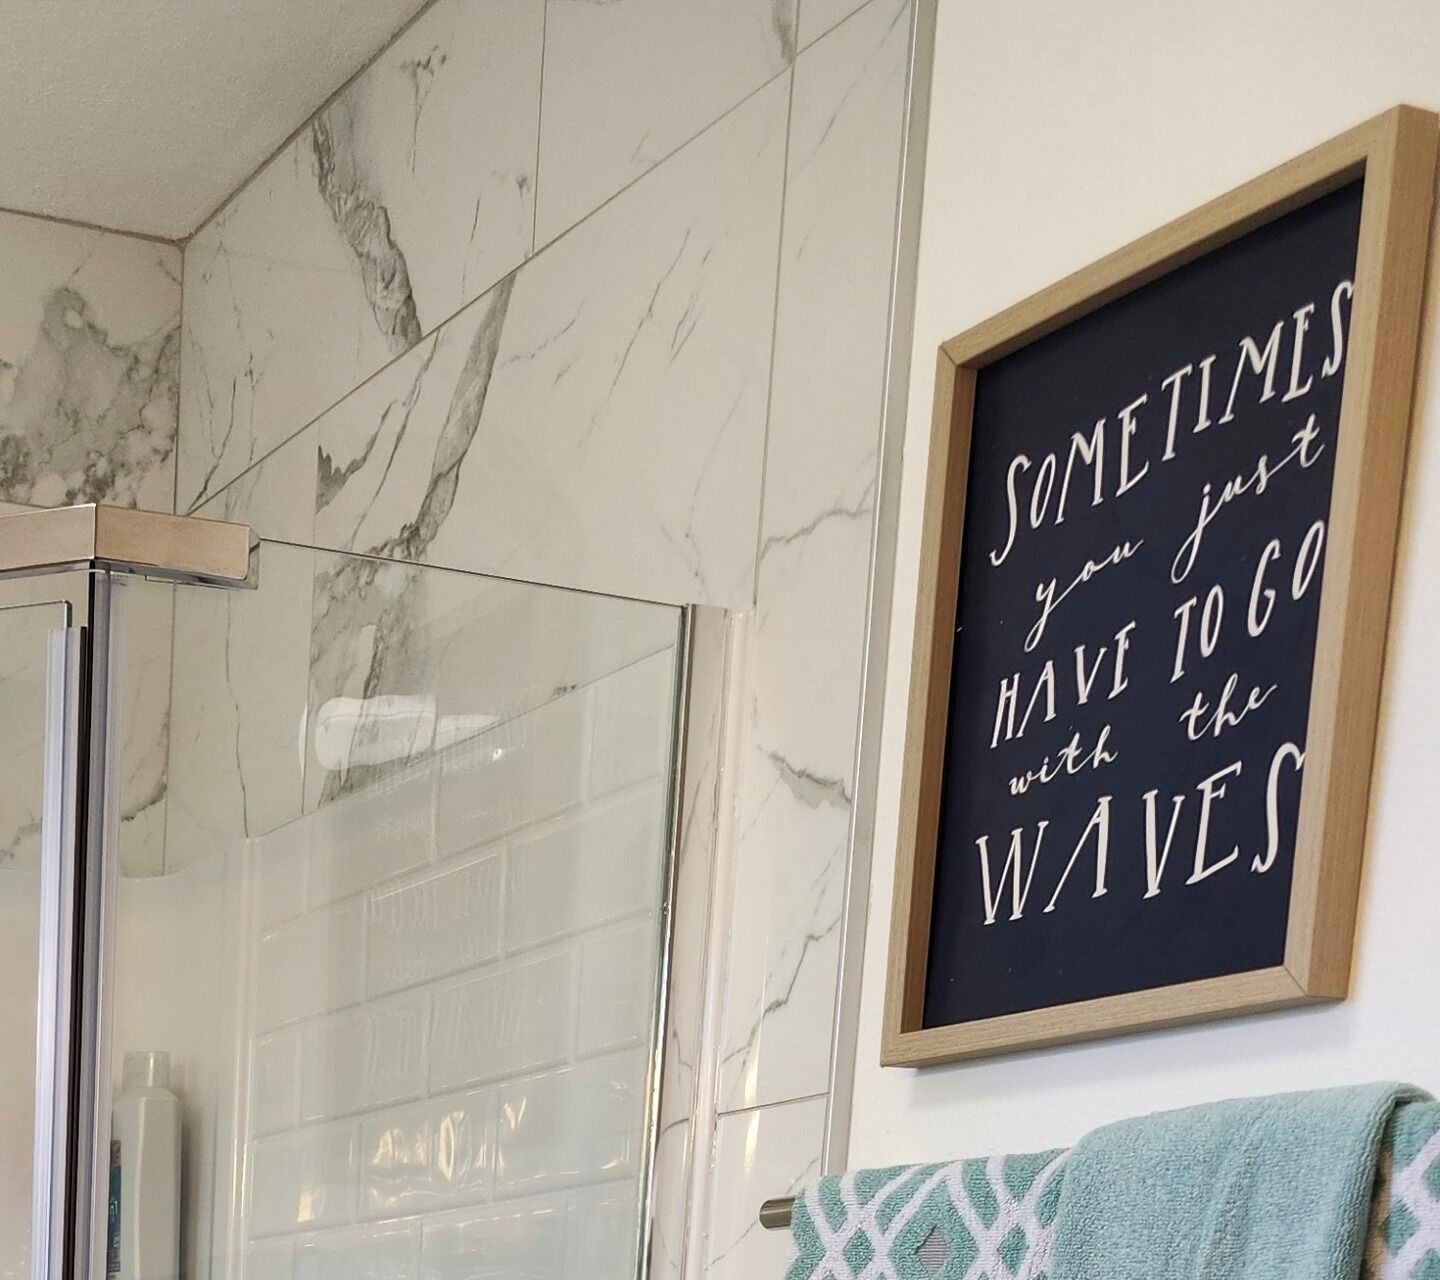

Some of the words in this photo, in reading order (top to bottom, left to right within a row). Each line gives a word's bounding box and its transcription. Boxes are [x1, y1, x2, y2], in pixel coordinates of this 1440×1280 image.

[990, 279, 1356, 566] SOMETIMES
[1025, 540, 1143, 652] you
[1171, 414, 1324, 583] just
[990, 621, 1135, 748] HAVE
[1171, 585, 1223, 683] TO
[1248, 521, 1324, 637] GO
[1009, 725, 1118, 795] with
[1179, 673, 1277, 740] the
[976, 742, 1304, 925] WAVES
